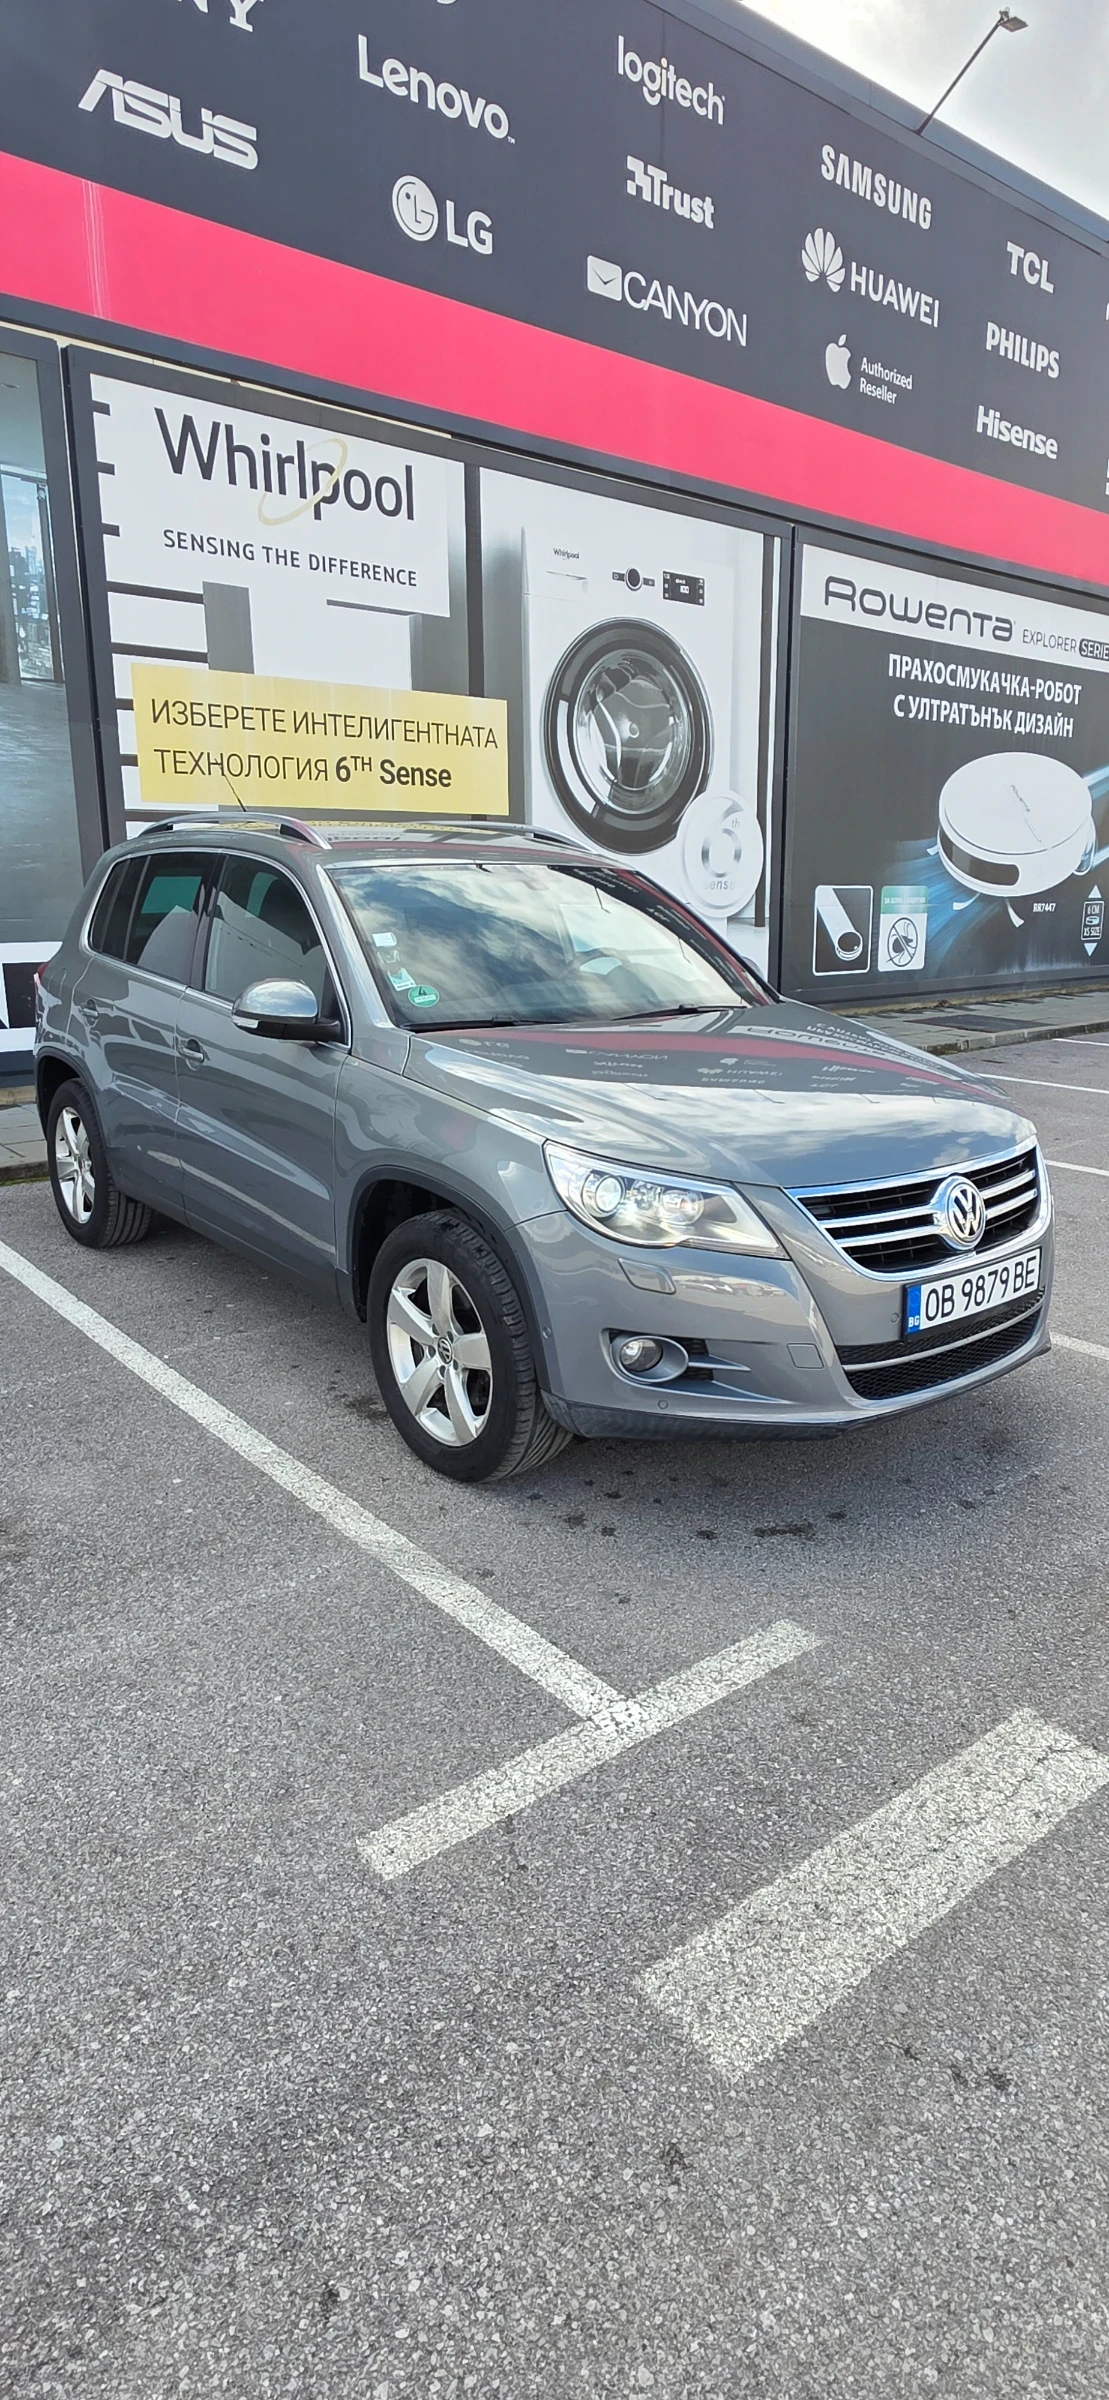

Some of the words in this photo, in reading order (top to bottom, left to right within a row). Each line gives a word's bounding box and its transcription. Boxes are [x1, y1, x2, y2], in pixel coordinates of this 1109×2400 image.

[358, 34, 510, 140] Lenovo
[617, 35, 725, 126] logitech
[78, 68, 259, 170] ASUS
[648, 164, 715, 230] Trust
[821, 145, 932, 230] SAMSUNG
[446, 199, 494, 255] LG
[850, 261, 939, 328] HUAWEI
[1006, 241, 1054, 294] TCL
[623, 270, 748, 347] CANYON
[861, 356, 913, 391] Authorized
[985, 322, 1060, 379] PHILIPS
[859, 376, 897, 405] Reseller
[976, 404, 1058, 460] Hisense
[154, 406, 415, 522] Whirlpool
[163, 528, 256, 561] SENSING
[262, 544, 301, 569] THE
[308, 553, 418, 588] DIFFERENCE
[553, 547, 580, 560] Whirlpool
[1022, 628, 1077, 653] EXPLORER
[888, 653, 1082, 706] ПРАХОСМУКАЧКА-РОБОТ
[151, 698, 287, 734] ИЗБЕРЕТЕ
[292, 710, 499, 749] ИНТЕЛИГЕНТНАТА
[893, 693, 905, 718] С
[908, 697, 1012, 732] УЛТРАТЪНЪК
[1015, 708, 1074, 739] ДИЗАЙН
[154, 748, 329, 782] ТЕХНОЛОГИЯ
[379, 758, 452, 788] Sense
[925, 1284, 955, 1322] OB
[961, 1266, 1010, 1312] 9879
[1013, 1255, 1037, 1294] BE
[908, 1316, 920, 1327] BG
